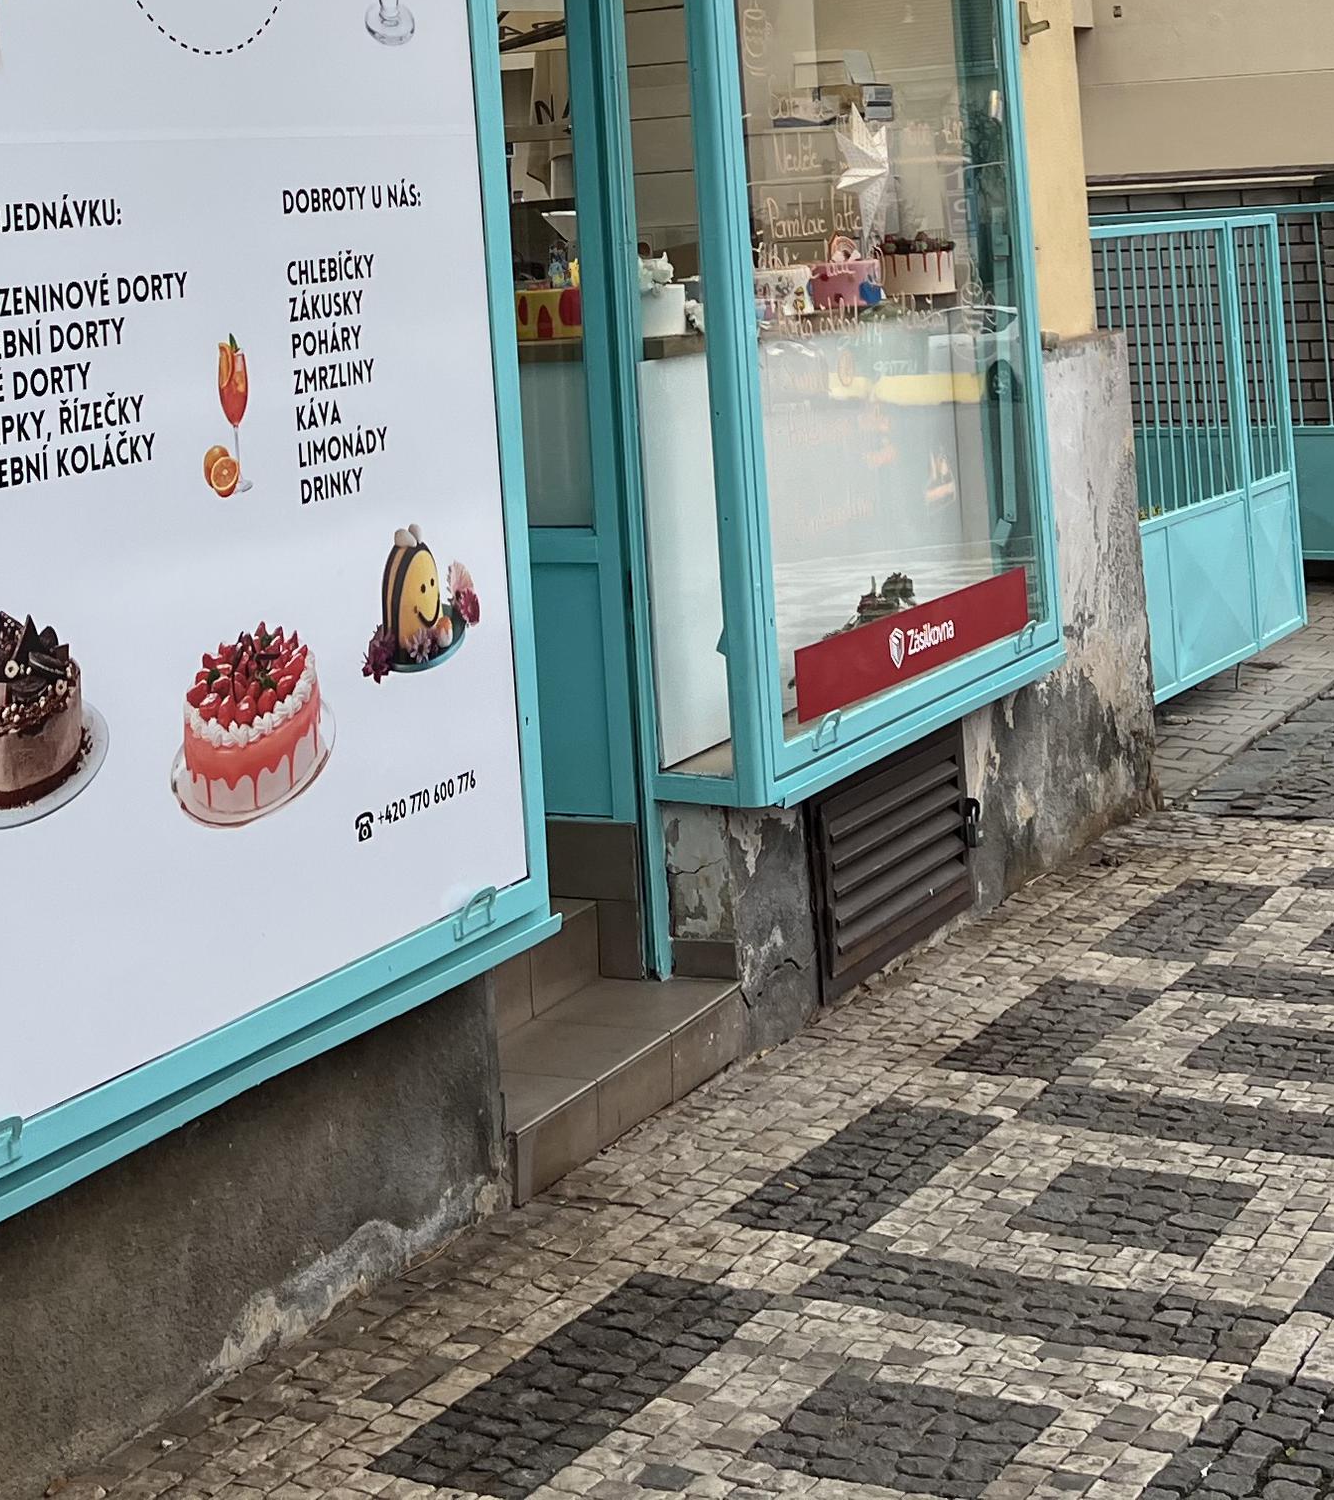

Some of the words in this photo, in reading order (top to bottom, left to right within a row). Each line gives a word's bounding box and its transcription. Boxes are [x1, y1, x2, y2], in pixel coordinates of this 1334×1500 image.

[282, 185, 366, 215] DOBROTY
[371, 185, 382, 209] U
[386, 178, 422, 208] NÁS:
[287, 249, 374, 286] CHLEBÍČKY
[117, 271, 188, 305] DORTY
[288, 289, 363, 323] ZÁKUSKY
[49, 316, 125, 354] DORTY
[291, 324, 362, 359] POHÁRY
[12, 361, 91, 401] DORTY
[293, 358, 374, 395] ZMRZLINY
[59, 391, 144, 435] ŘÍZEČKY
[295, 400, 342, 432] KÁVA
[56, 430, 156, 478] KOLÁČKY
[298, 424, 388, 468] LIMONÁDY
[300, 466, 363, 505] DRINKY
[907, 619, 954, 656] Zásilkovna
[378, 798, 406, 824] +420
[409, 788, 430, 815] 770
[433, 778, 455, 804] 600
[457, 769, 476, 794] 776
